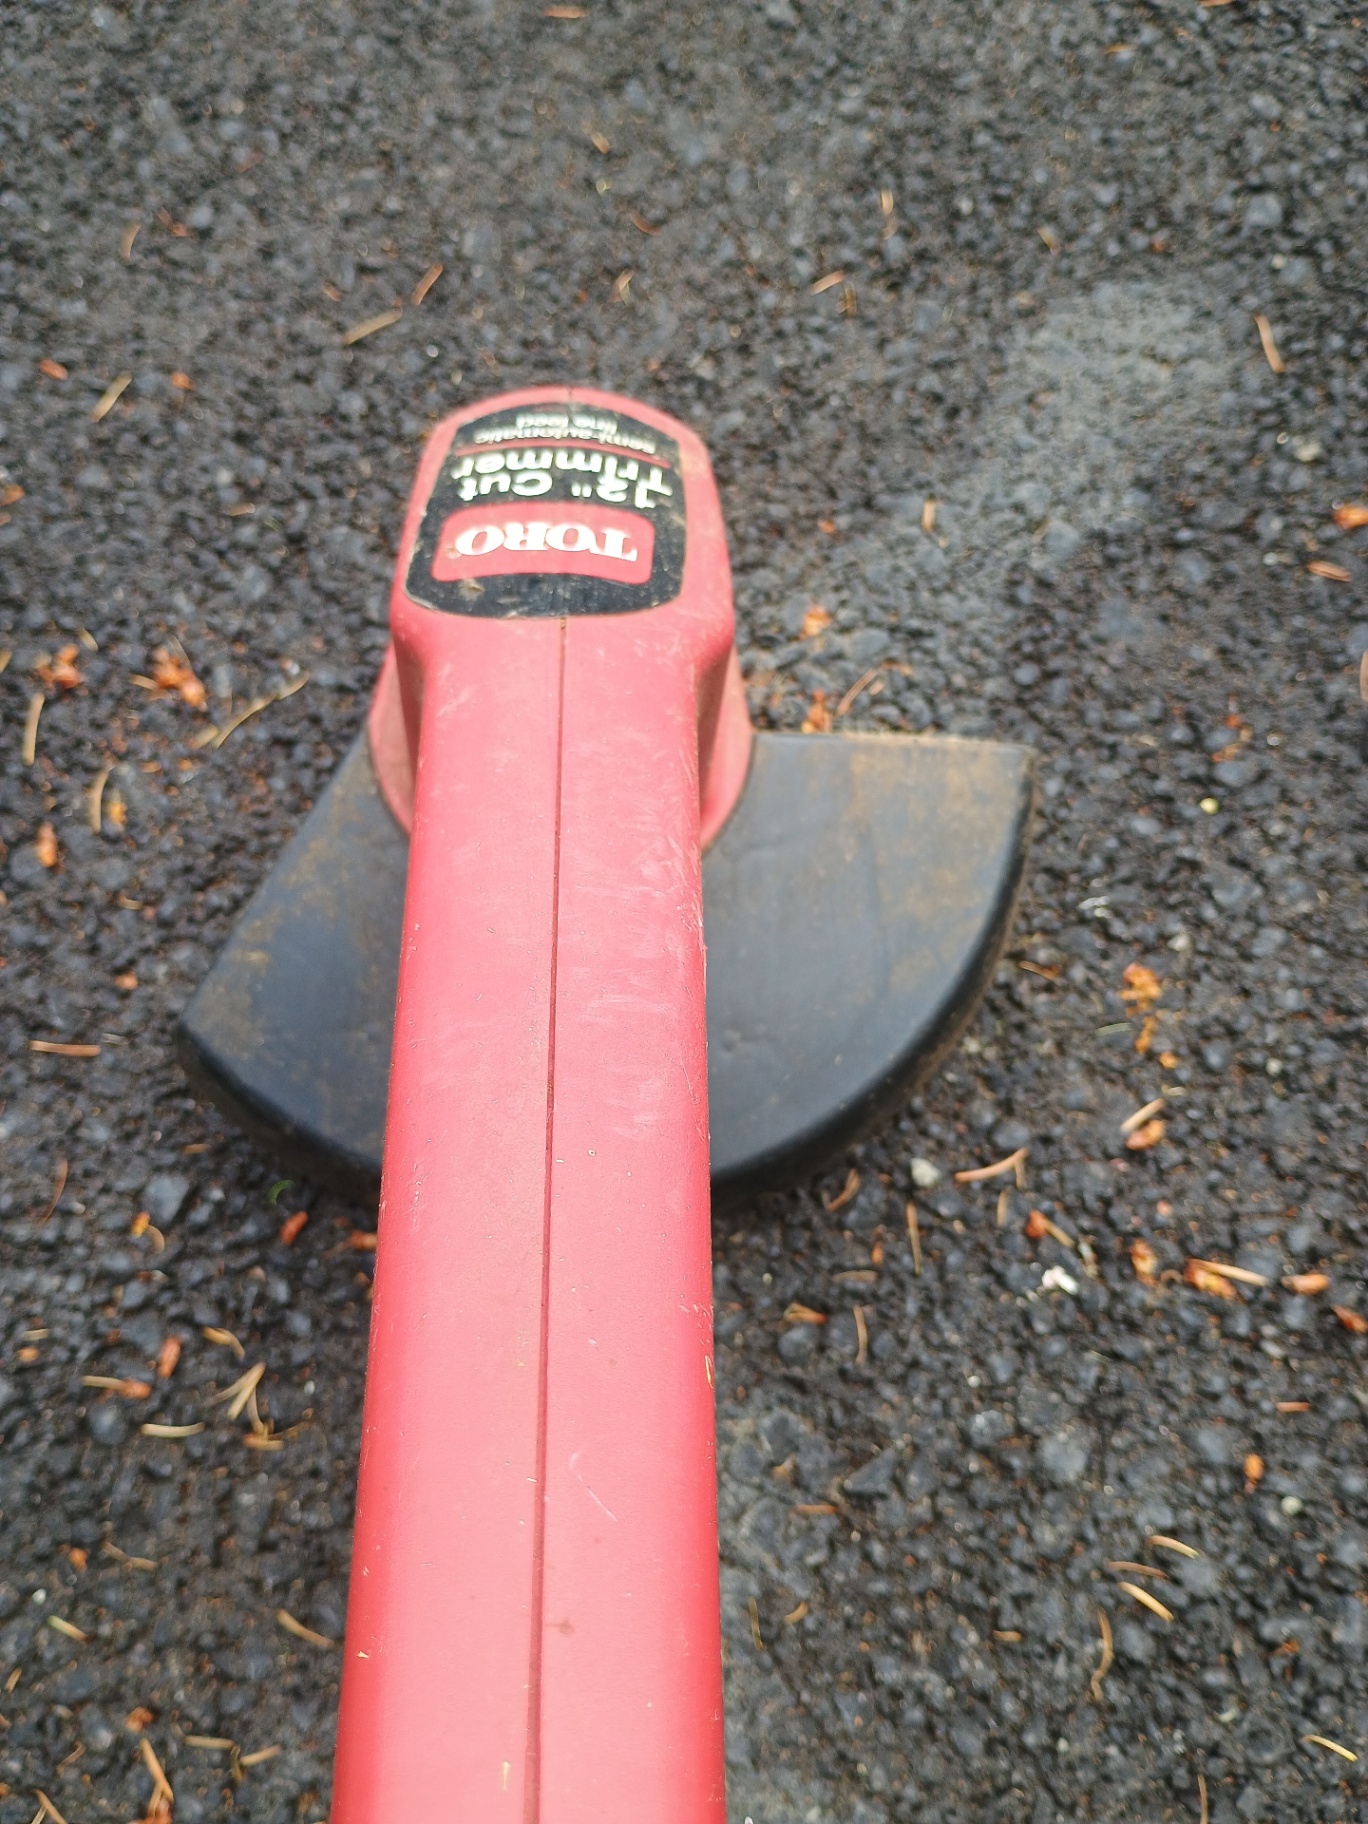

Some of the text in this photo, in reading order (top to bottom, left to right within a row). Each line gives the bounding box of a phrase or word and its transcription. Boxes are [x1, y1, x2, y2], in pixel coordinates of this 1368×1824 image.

[451, 449, 673, 497] Trimmer
[457, 469, 553, 501] Cut
[455, 520, 638, 562] TORO
